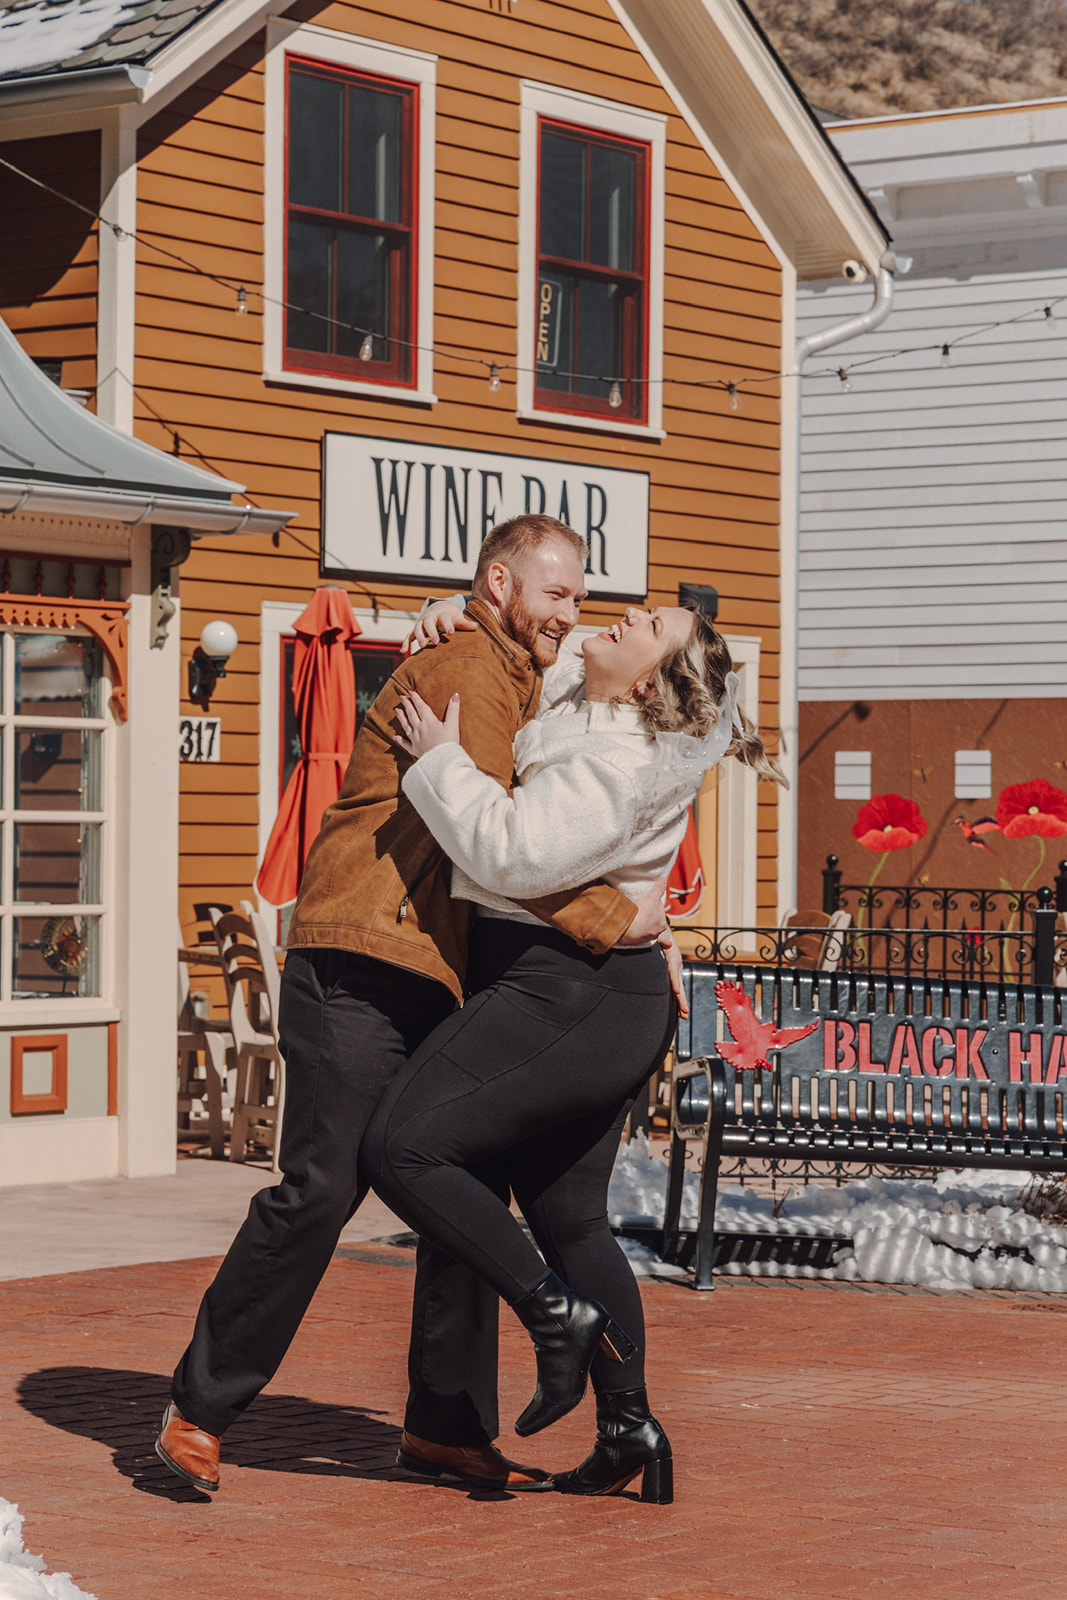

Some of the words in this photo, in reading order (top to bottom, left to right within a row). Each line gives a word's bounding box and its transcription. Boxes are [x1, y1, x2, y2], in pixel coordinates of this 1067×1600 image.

[537, 283, 552, 362] OPEN
[370, 456, 503, 564] WINE
[180, 720, 217, 759] 317
[824, 1019, 990, 1080] BLACK
